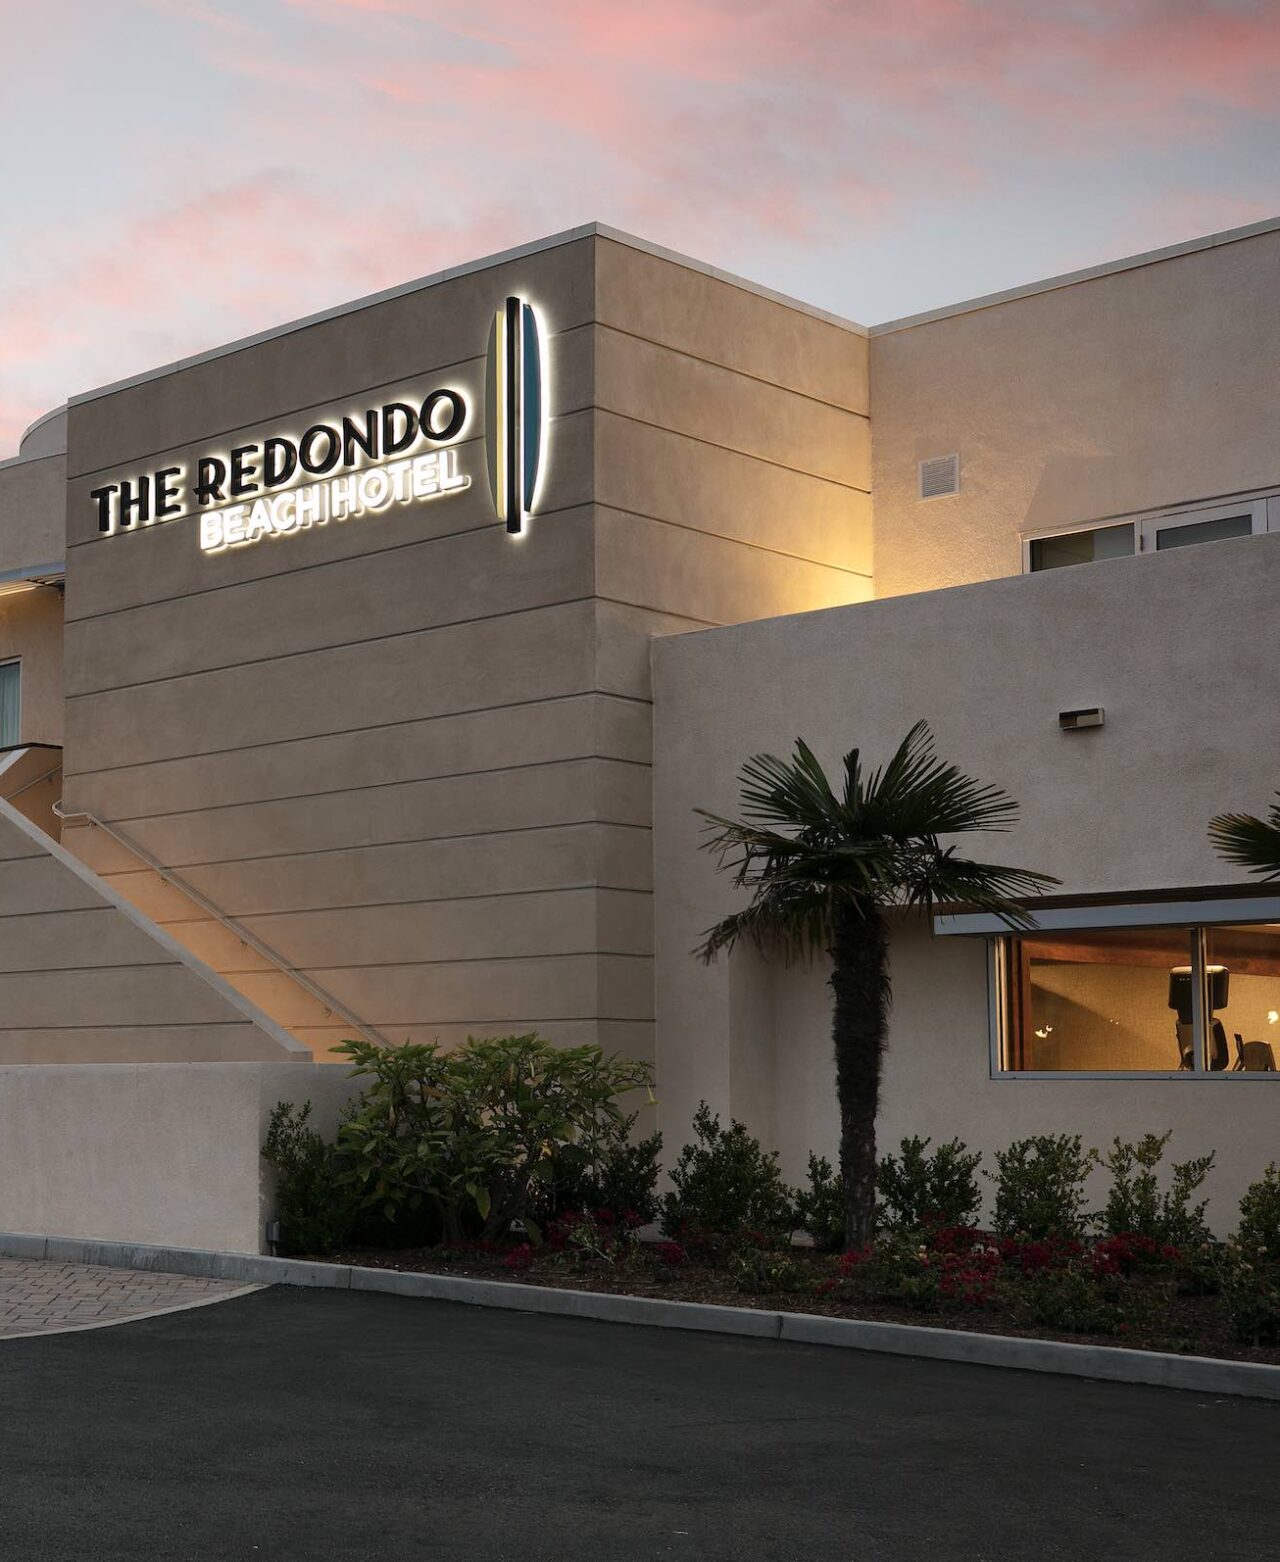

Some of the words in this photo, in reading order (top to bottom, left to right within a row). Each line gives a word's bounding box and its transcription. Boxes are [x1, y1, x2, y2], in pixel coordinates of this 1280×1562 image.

[90, 467, 182, 532] THE
[193, 388, 467, 506] REDONDO
[200, 484, 327, 551] BEACH
[331, 450, 468, 519] HOTEL
